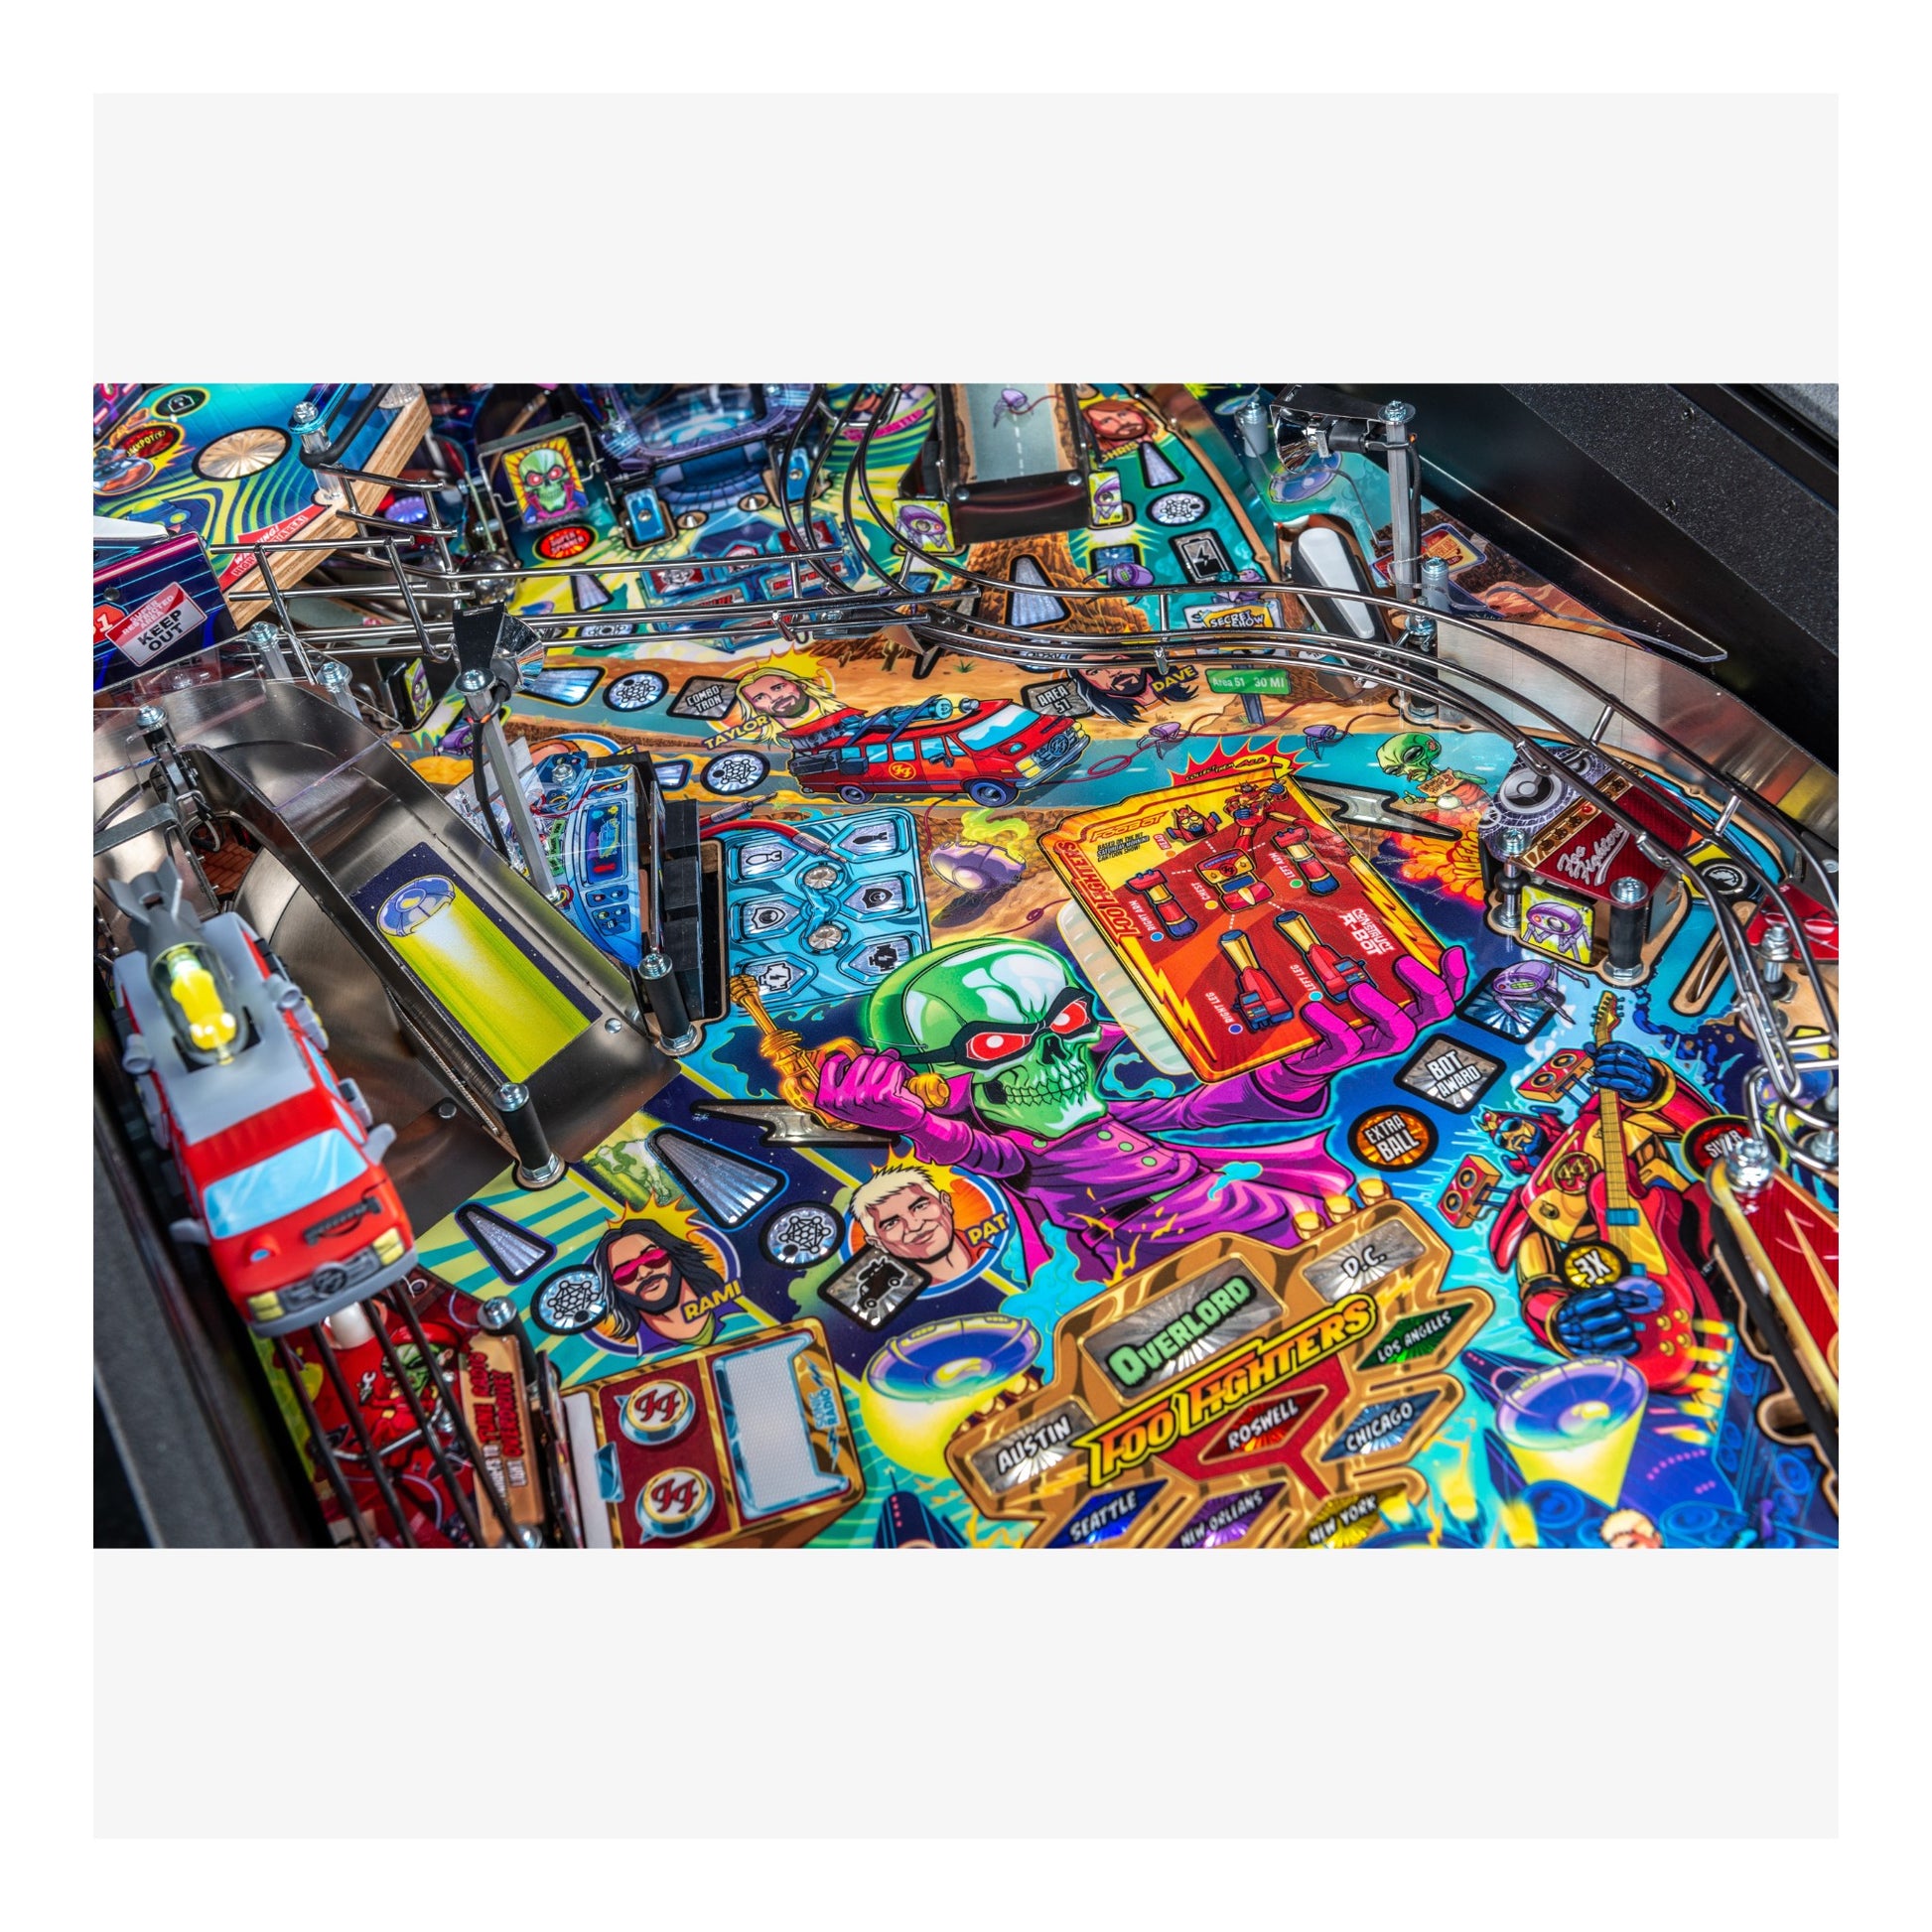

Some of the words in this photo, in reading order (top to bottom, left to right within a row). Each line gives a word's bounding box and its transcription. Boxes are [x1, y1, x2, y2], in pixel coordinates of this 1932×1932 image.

[122, 596, 174, 634] RESTRICTED
[137, 610, 182, 645] KEEP
[141, 611, 165, 629] AREA
[148, 622, 183, 651] OUT
[686, 684, 724, 706] COMBO-
[1152, 665, 1196, 693] DAVE
[1212, 677, 1233, 687] Area
[1234, 677, 1249, 687] 51
[1254, 677, 1268, 687] 30
[1270, 677, 1285, 687] MI
[696, 695, 723, 713] TRON
[1036, 685, 1069, 707] AREA
[1053, 699, 1071, 714] 51
[704, 715, 769, 750] TAYLOR
[1090, 810, 1170, 843] FOOBOT
[1190, 882, 1211, 900] CHEST
[1351, 907, 1395, 953] CONSTRUCT
[1427, 1049, 1463, 1081] BOT
[1436, 1063, 1483, 1098] AWARD
[1364, 1113, 1406, 1145] EXTRA
[1378, 1133, 1421, 1163] BALL
[967, 1214, 1008, 1246] PAT
[1340, 1247, 1388, 1281] D.C.
[683, 1281, 742, 1321] RAMI
[1107, 1275, 1254, 1388] OVERLORD
[1377, 1340, 1402, 1364] LOS
[1099, 1398, 1175, 1477] FOO
[1185, 1301, 1374, 1427] FIGHTERS
[820, 1387, 841, 1427] RADIO
[1227, 1398, 1299, 1451] ROSWELL
[1345, 1401, 1414, 1451] CHICAGO
[996, 1415, 1073, 1474] AUSTIN
[1069, 1489, 1138, 1543] SEATTLE
[1340, 1494, 1377, 1526] YORK
